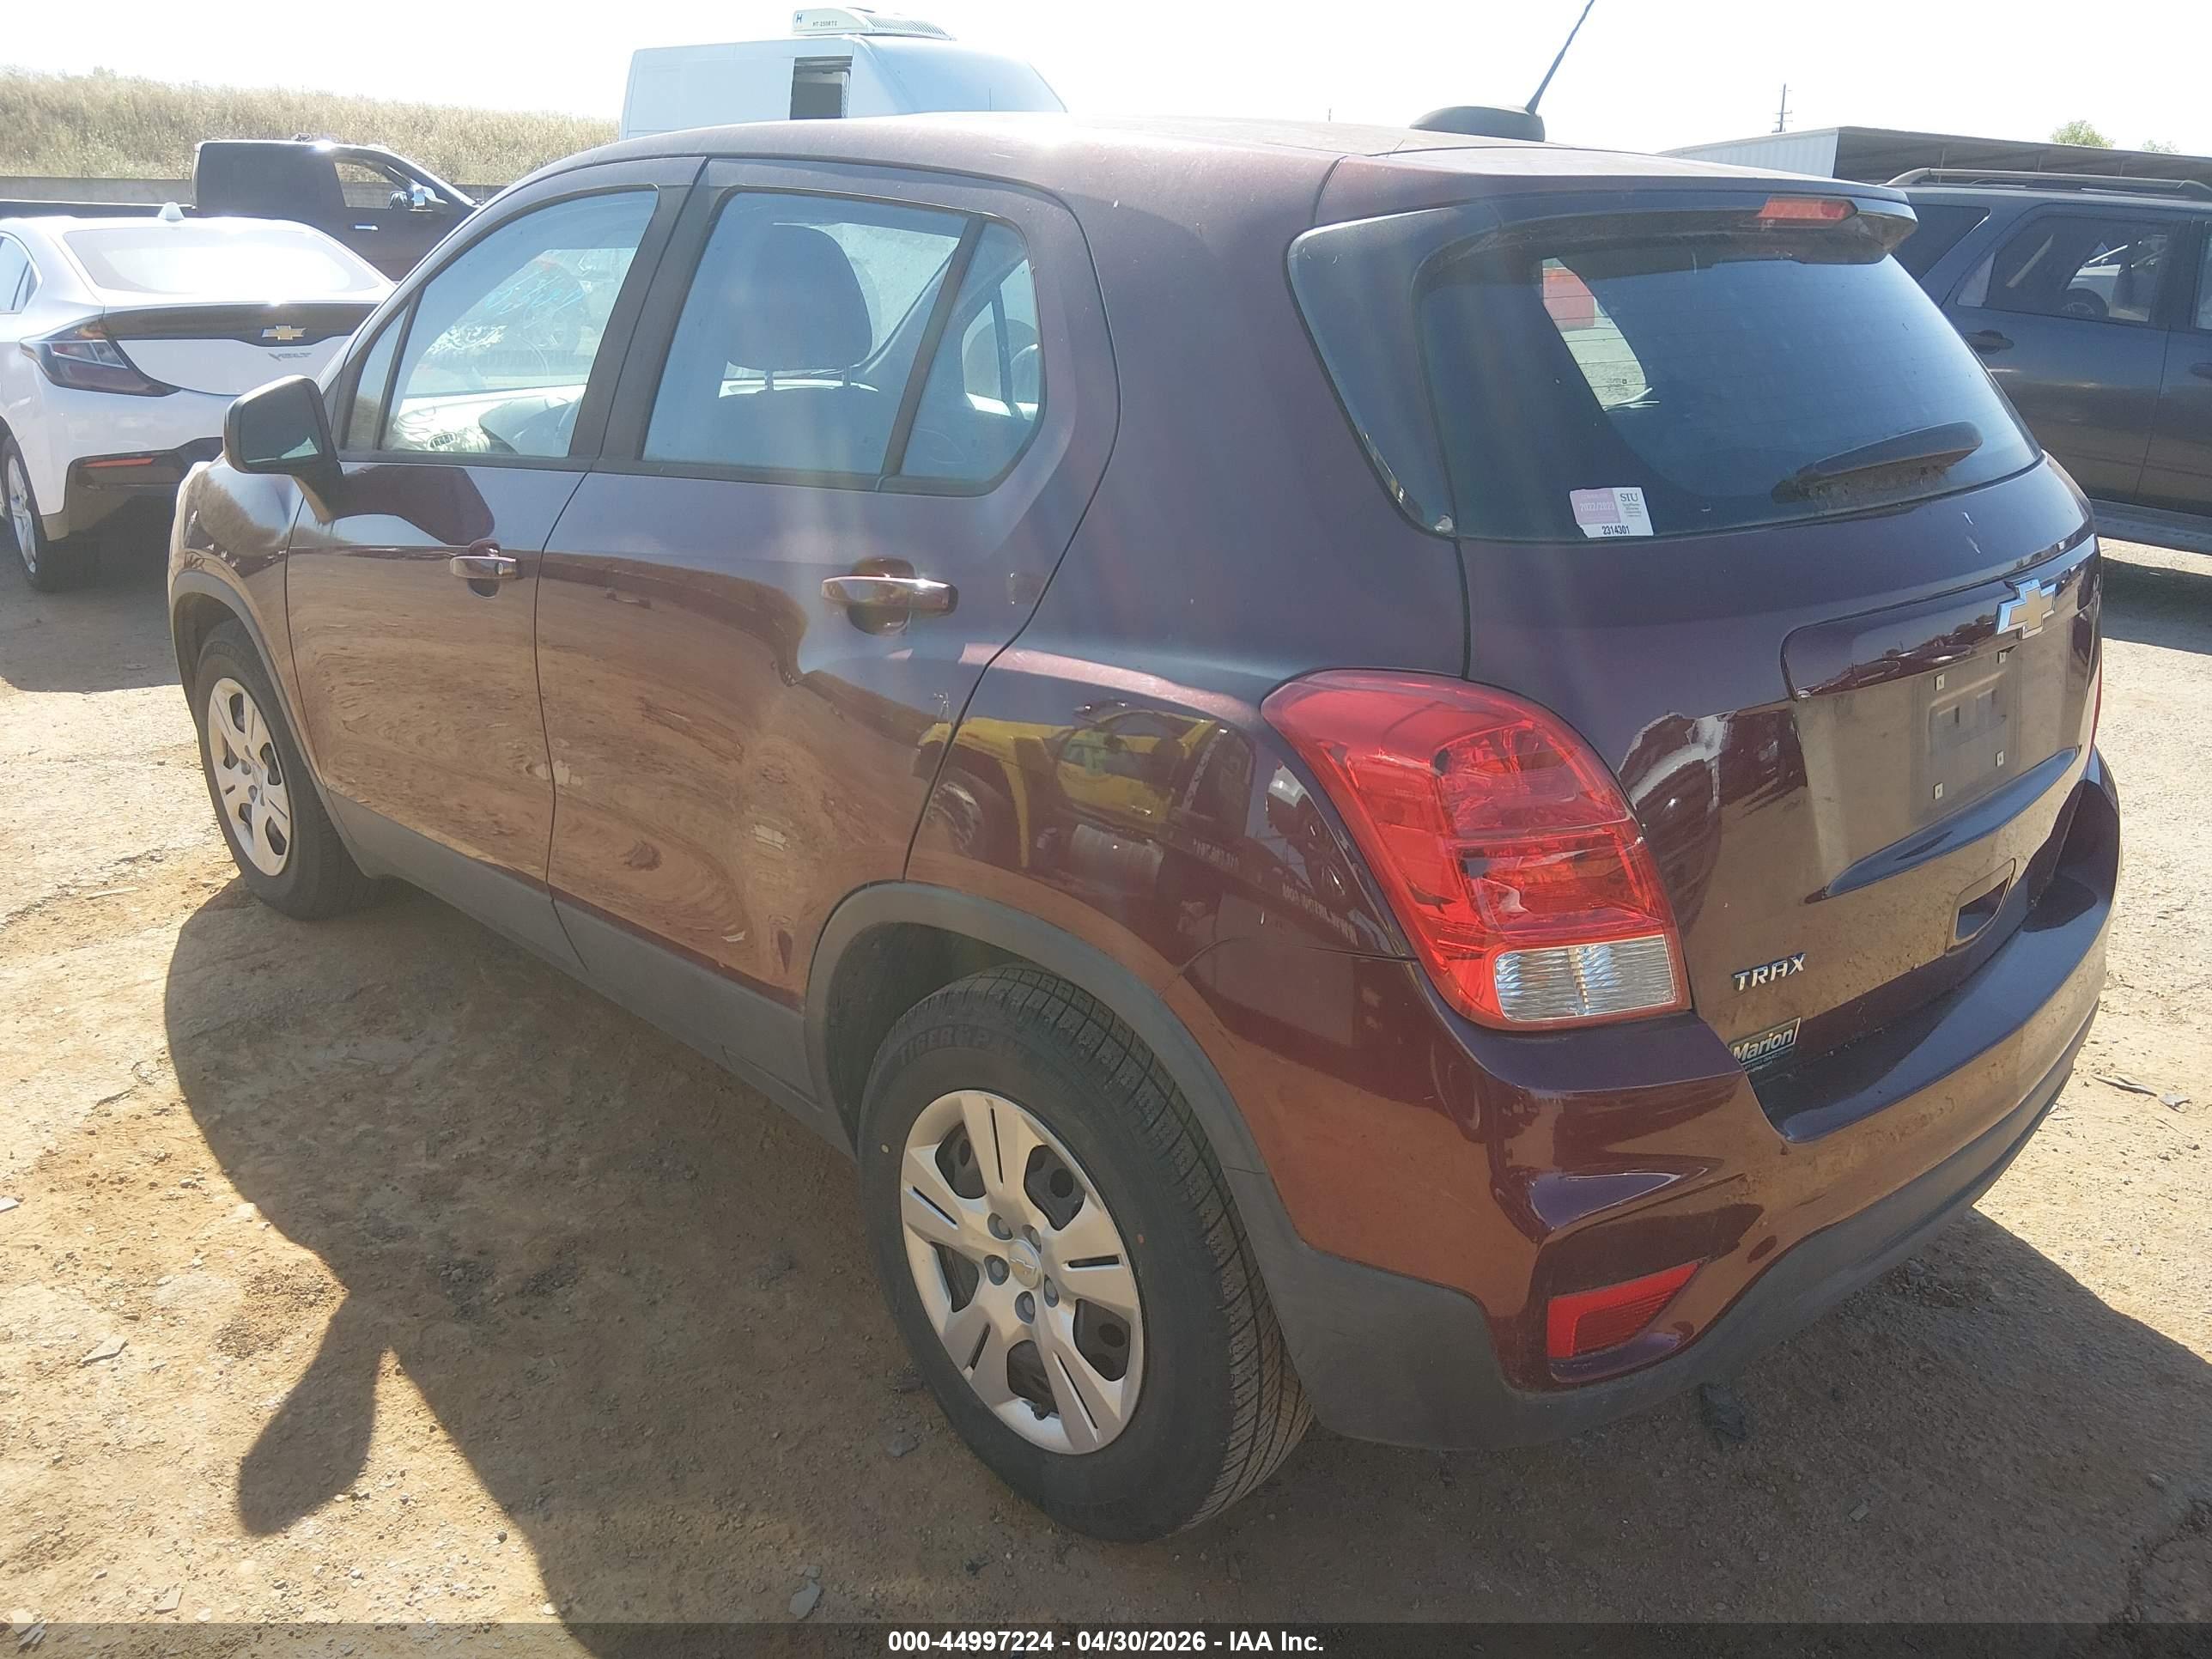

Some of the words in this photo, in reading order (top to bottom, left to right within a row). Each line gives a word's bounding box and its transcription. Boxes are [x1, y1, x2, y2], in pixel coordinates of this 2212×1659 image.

[1620, 493, 1638, 501] SIU
[1601, 526, 1630, 535] 2314301
[1732, 952, 1807, 991] TRAX
[1733, 1028, 1793, 1061] Marion
